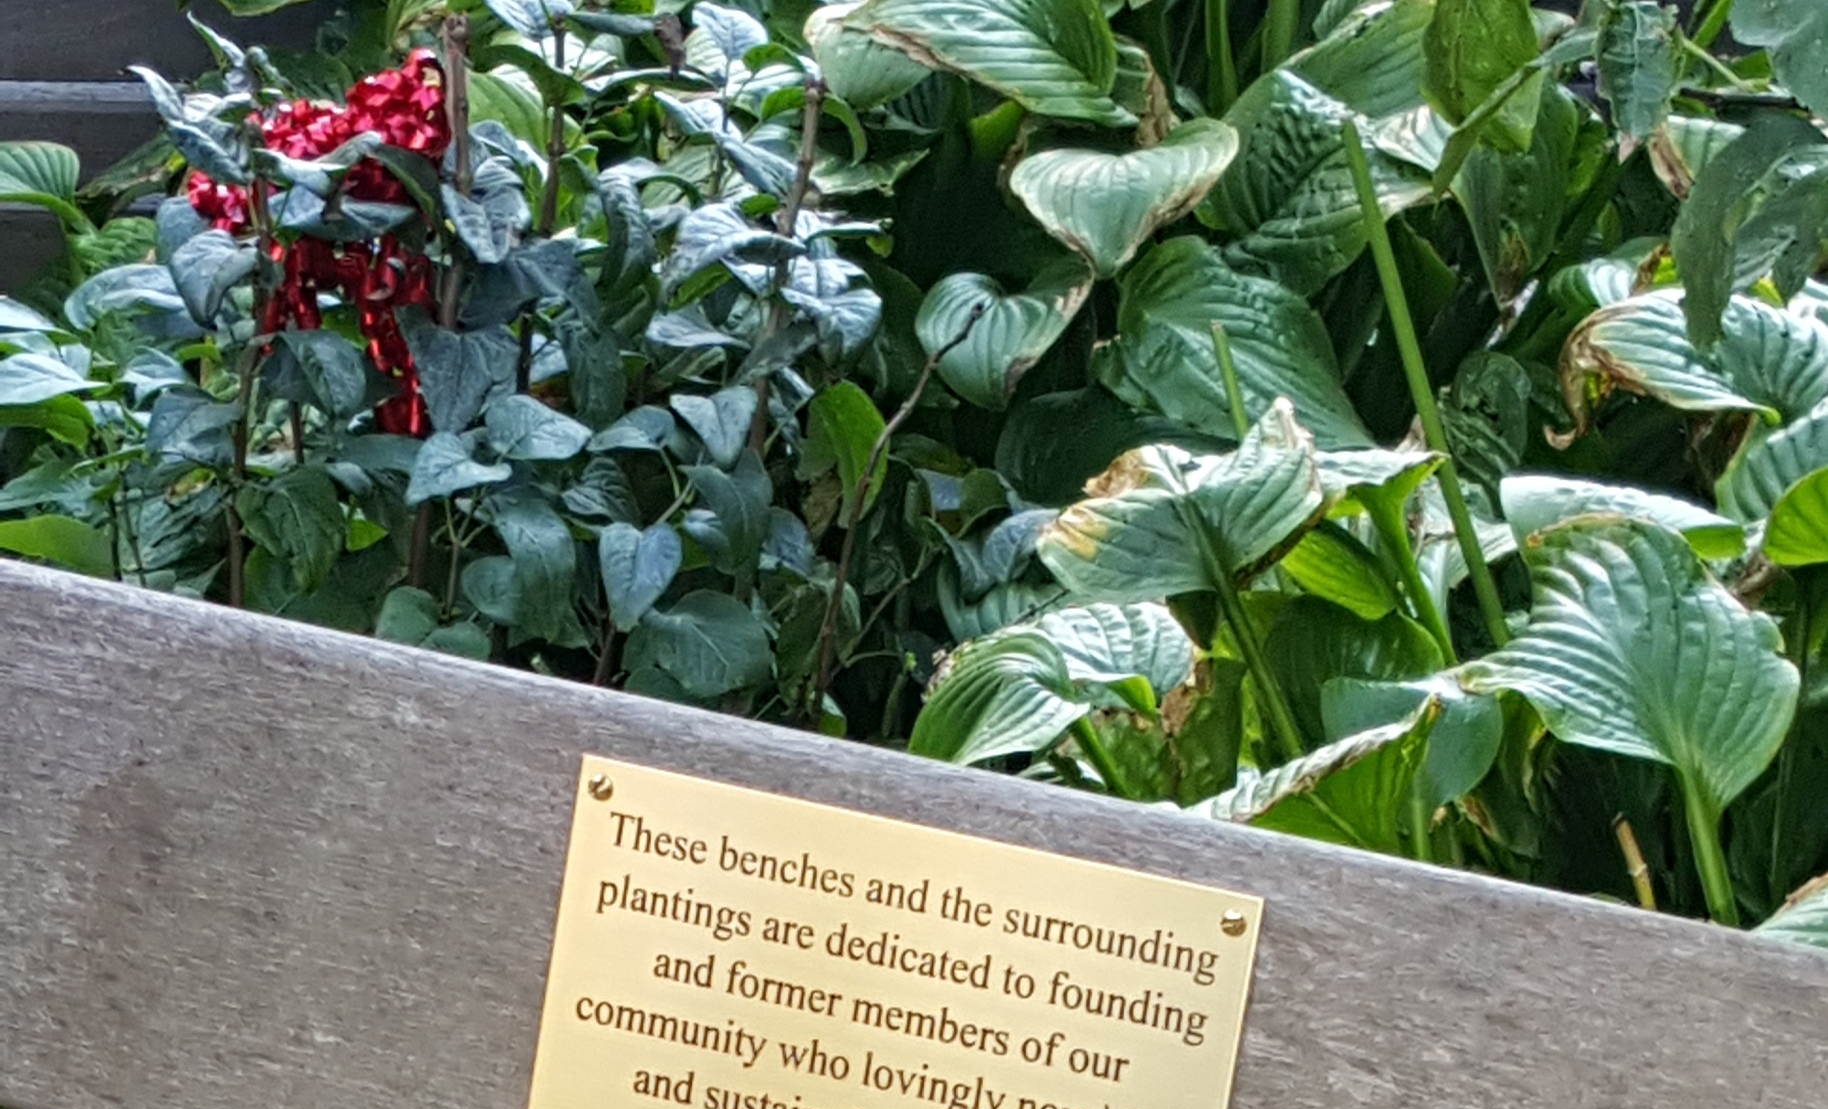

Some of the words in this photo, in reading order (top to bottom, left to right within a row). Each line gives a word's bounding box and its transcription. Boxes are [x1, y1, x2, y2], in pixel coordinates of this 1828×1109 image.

[595, 873, 752, 942] plantings
[762, 917, 815, 950] are
[825, 922, 993, 990] dedicated
[1002, 965, 1036, 1000] to
[1048, 970, 1209, 1047] founding
[610, 810, 708, 865] These
[718, 835, 855, 898] benches
[865, 878, 930, 914] and
[940, 886, 993, 928] the
[1002, 908, 1220, 987] surrounding
[575, 997, 768, 1069] community
[778, 1038, 850, 1081] who
[653, 954, 716, 989] and
[725, 960, 843, 1017] former
[851, 998, 1010, 1056] members
[1020, 1031, 1066, 1067] of
[1068, 1048, 1131, 1082] our
[632, 1070, 695, 1106] and
